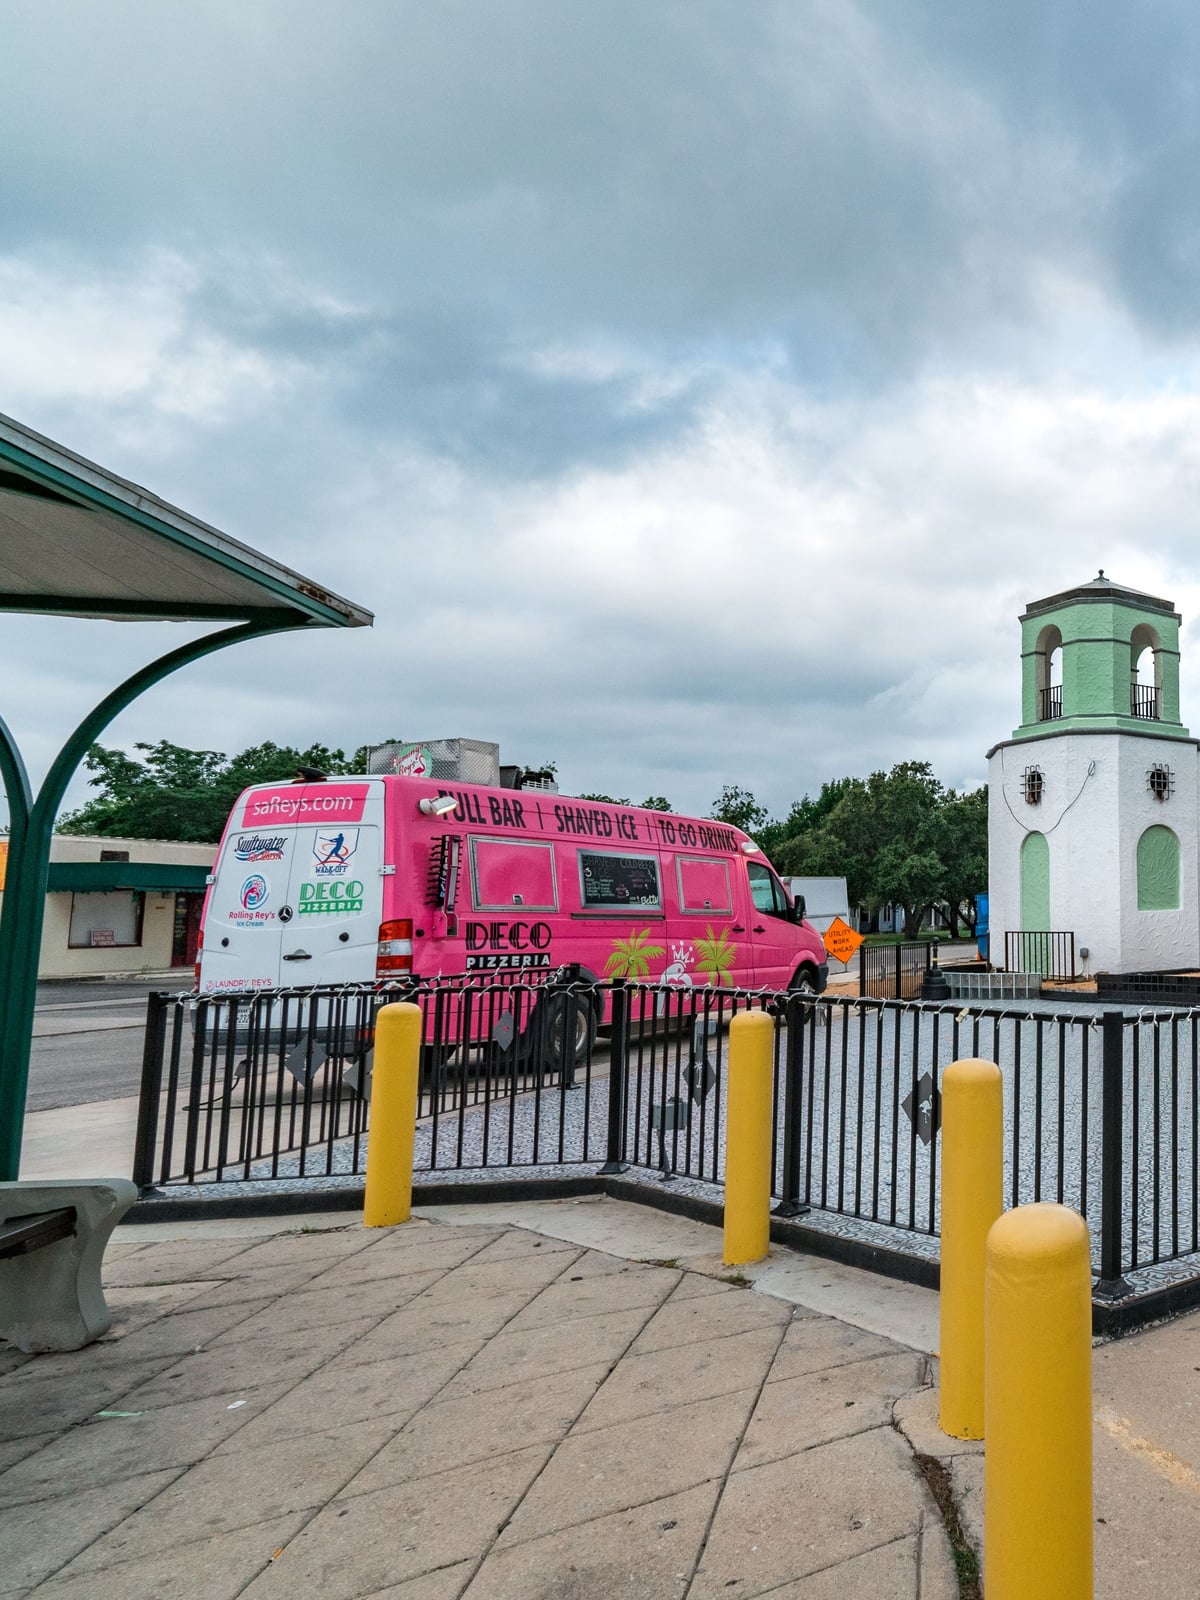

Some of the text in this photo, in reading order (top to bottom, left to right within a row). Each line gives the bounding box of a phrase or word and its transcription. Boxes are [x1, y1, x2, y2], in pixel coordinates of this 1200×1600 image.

[253, 796, 353, 817] saReys.com
[488, 796, 527, 828] BAR
[554, 805, 639, 841] SHAVED ICE
[658, 819, 739, 853] TO GO DRINKS
[300, 880, 364, 901] DECO
[229, 911, 275, 921] Rolling Rey's
[300, 901, 361, 912] PIZZERIA
[465, 922, 552, 950] DECO
[829, 929, 851, 937] UTILITY
[833, 945, 854, 953] AHEAD
[466, 954, 550, 969] PIZZERIA
